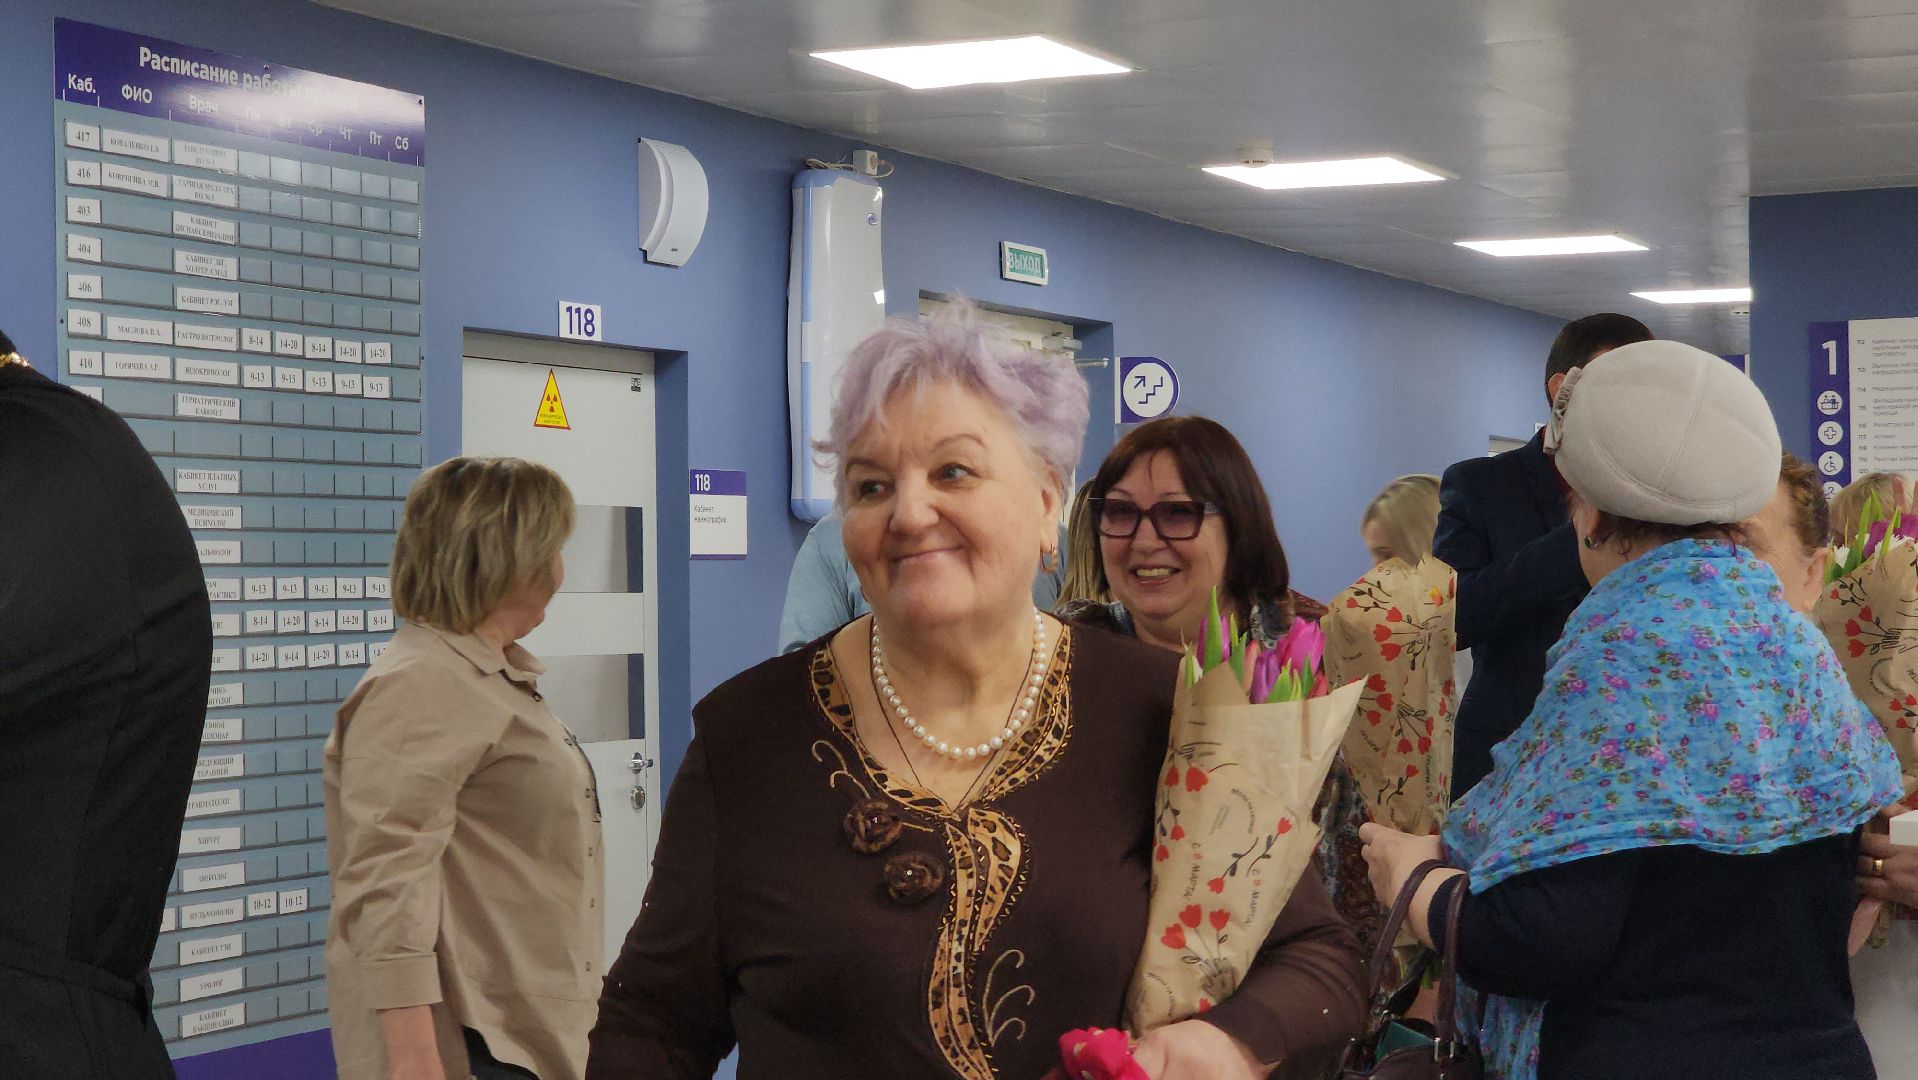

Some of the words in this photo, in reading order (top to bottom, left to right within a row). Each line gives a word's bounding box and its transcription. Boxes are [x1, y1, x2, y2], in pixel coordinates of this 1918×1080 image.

[139, 46, 239, 87] Расписание
[242, 72, 300, 97] работы
[67, 73, 97, 94] Каб.
[121, 83, 153, 104] ФИО
[189, 94, 219, 115] Врач
[309, 119, 323, 136] Ср
[338, 124, 353, 141] Чт
[369, 130, 383, 146] Пт
[395, 135, 410, 151] Сб
[76, 131, 91, 142] 417
[77, 168, 92, 179] 416
[77, 205, 91, 216] 403
[77, 243, 91, 254] 404
[1007, 253, 1041, 275] ВЫХОД
[78, 281, 92, 292] 406
[77, 315, 92, 327] 408
[565, 305, 596, 337] 118
[249, 335, 264, 346] 8-14
[280, 339, 298, 349] 14-20
[311, 343, 326, 353] 8-14
[339, 347, 357, 357] 14-20
[370, 348, 387, 358] 14-20
[79, 358, 93, 369] 410
[1821, 340, 1837, 376] 1
[250, 371, 264, 382] 9-13
[281, 374, 296, 384] 9-13
[341, 380, 355, 389] 9-13
[369, 383, 383, 392] 9-13
[694, 473, 711, 491] 118
[251, 585, 267, 594] 9-13
[282, 585, 298, 595] 9-13
[314, 585, 329, 594] 9-13
[342, 585, 357, 594] 9-13
[371, 584, 386, 593] 9-13
[253, 615, 268, 626] 8-14
[282, 616, 301, 627] 14-20
[314, 618, 329, 628] 8-14
[342, 615, 359, 625] 14-20
[373, 616, 387, 625] 8-14
[251, 652, 270, 663] 14-20
[284, 651, 299, 661] 8-14
[313, 650, 330, 660] 14-20
[345, 648, 359, 659] 8-14
[253, 898, 272, 910] 10-12
[284, 895, 303, 908] 10-12
